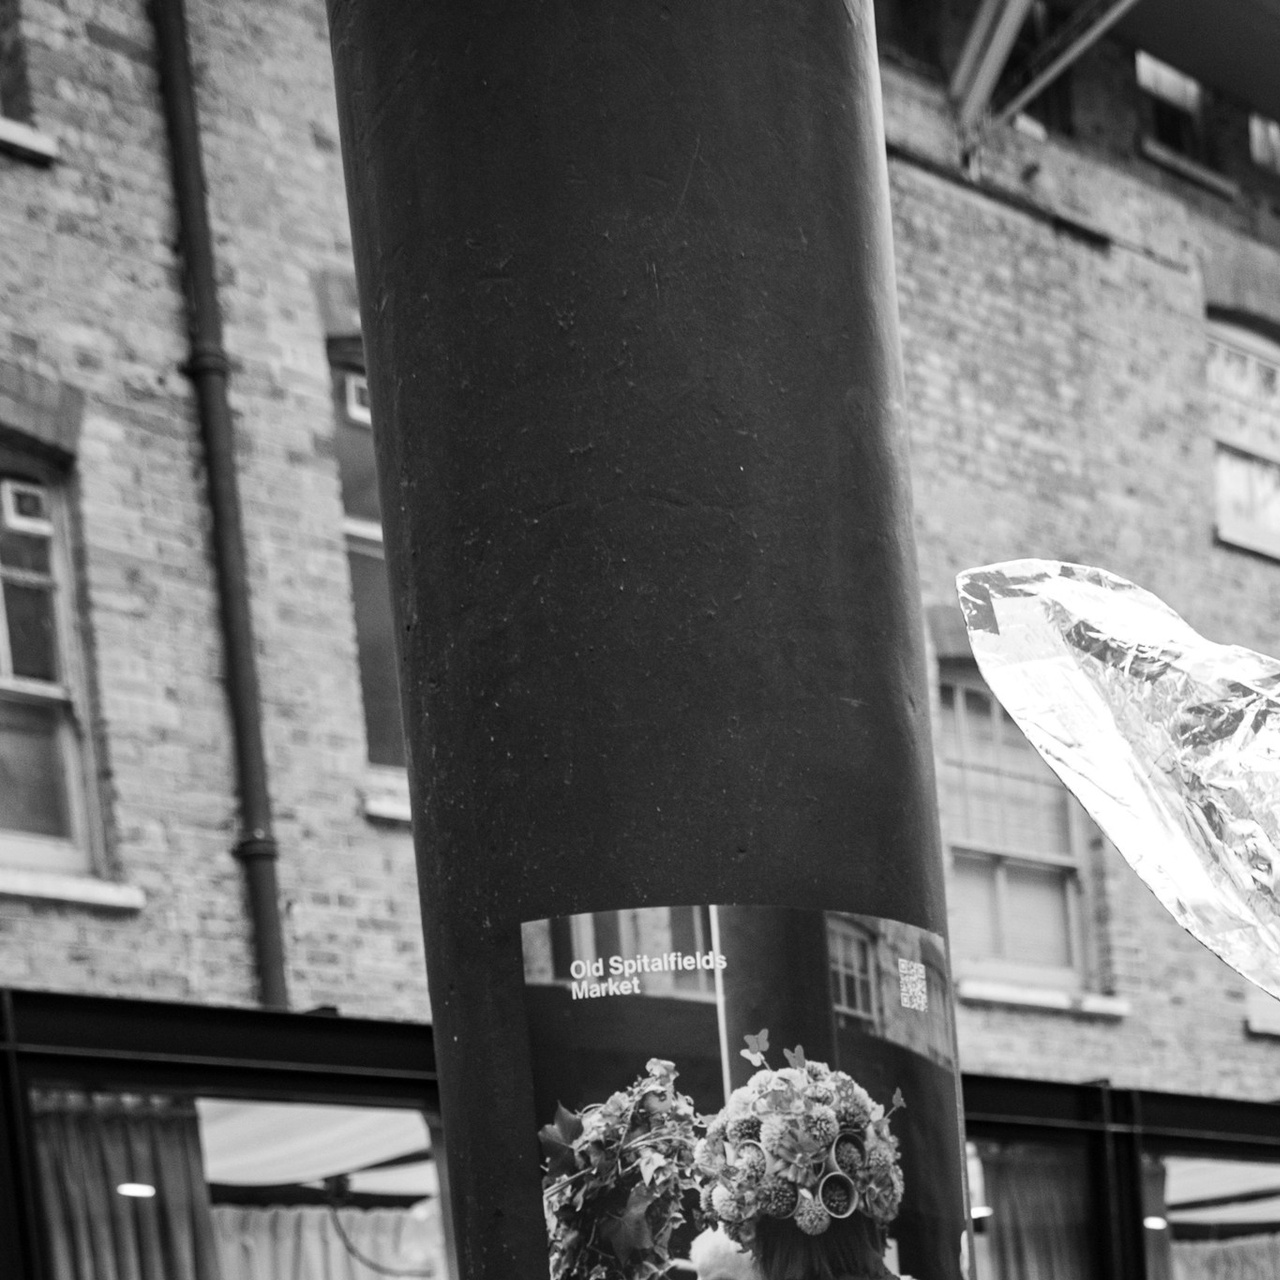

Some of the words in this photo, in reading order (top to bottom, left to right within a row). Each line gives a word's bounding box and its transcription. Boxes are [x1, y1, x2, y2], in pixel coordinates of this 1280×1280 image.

[570, 958, 604, 979] Old
[608, 951, 728, 977] Spitalfields
[571, 976, 641, 1000] Market
